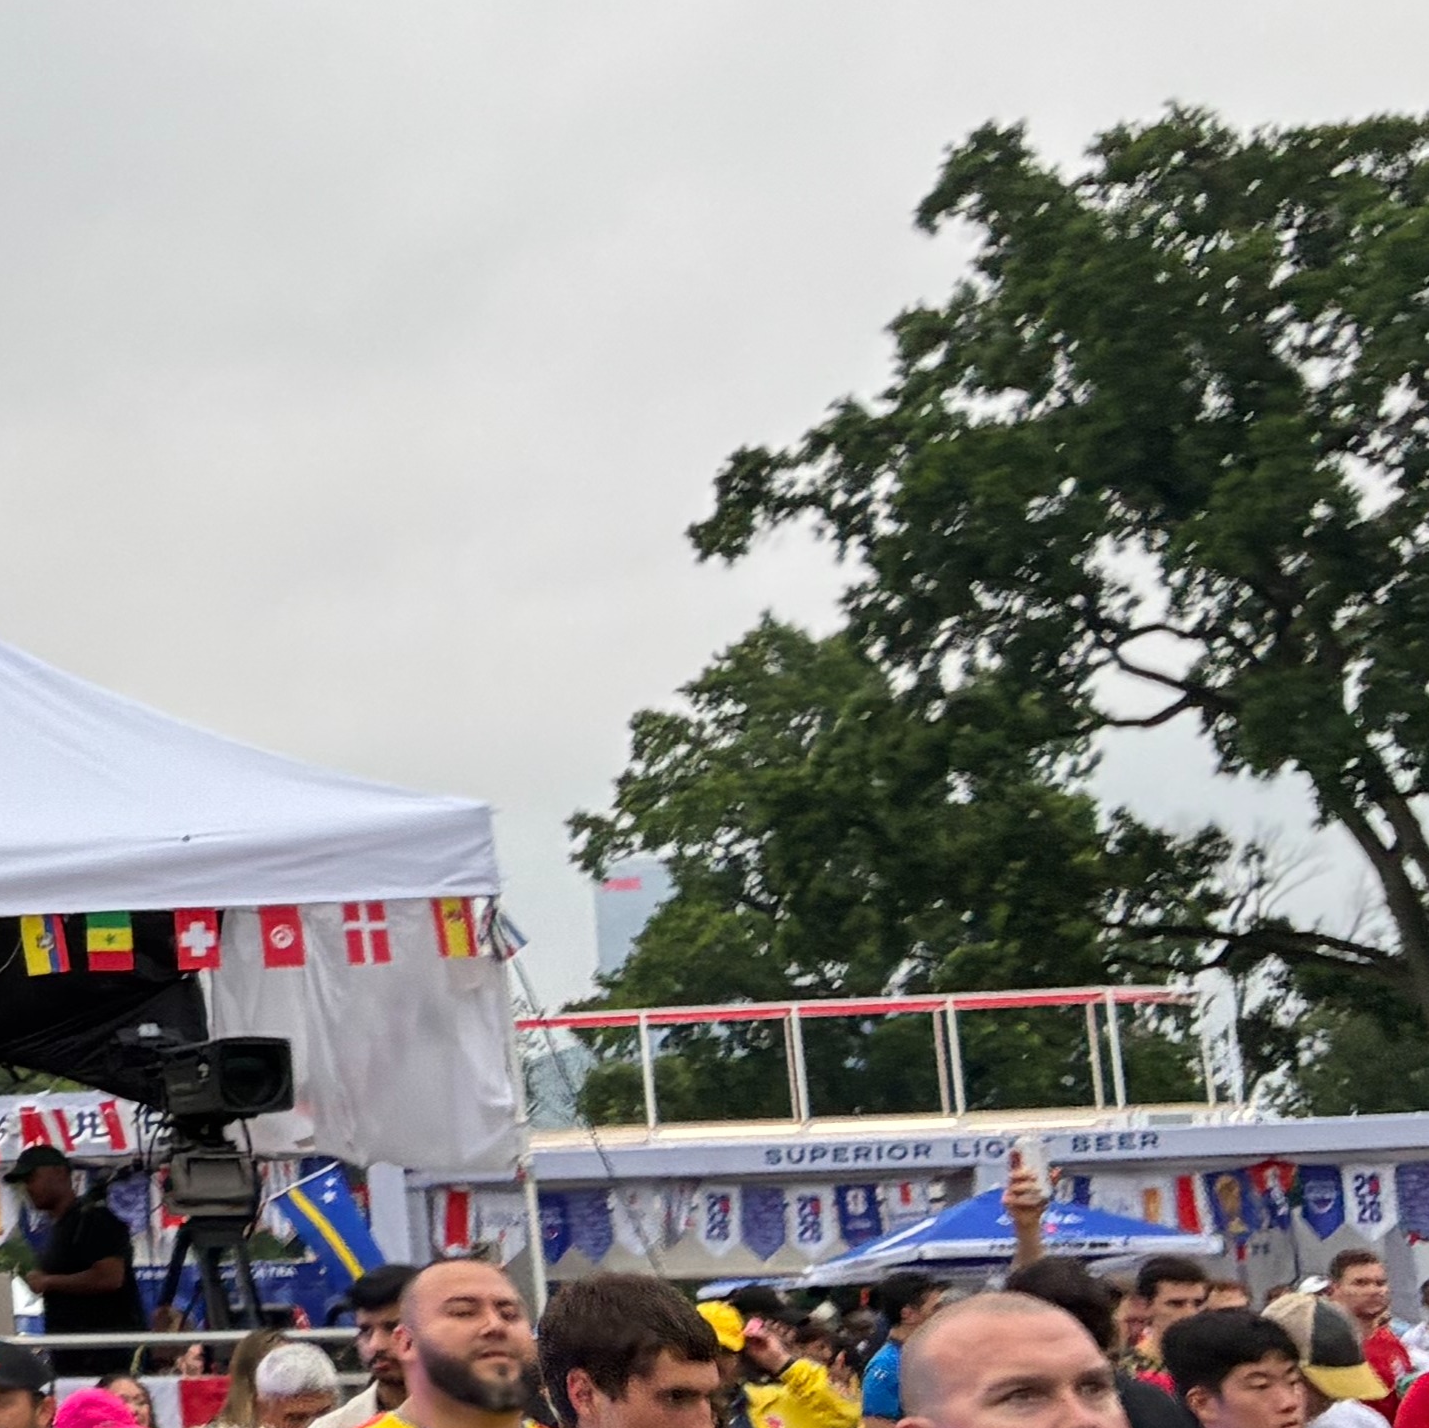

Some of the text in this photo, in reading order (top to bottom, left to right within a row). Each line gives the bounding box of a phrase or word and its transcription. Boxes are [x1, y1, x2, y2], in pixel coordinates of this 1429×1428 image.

[764, 1131, 1160, 1166] SUPERIOR LIG BEER
